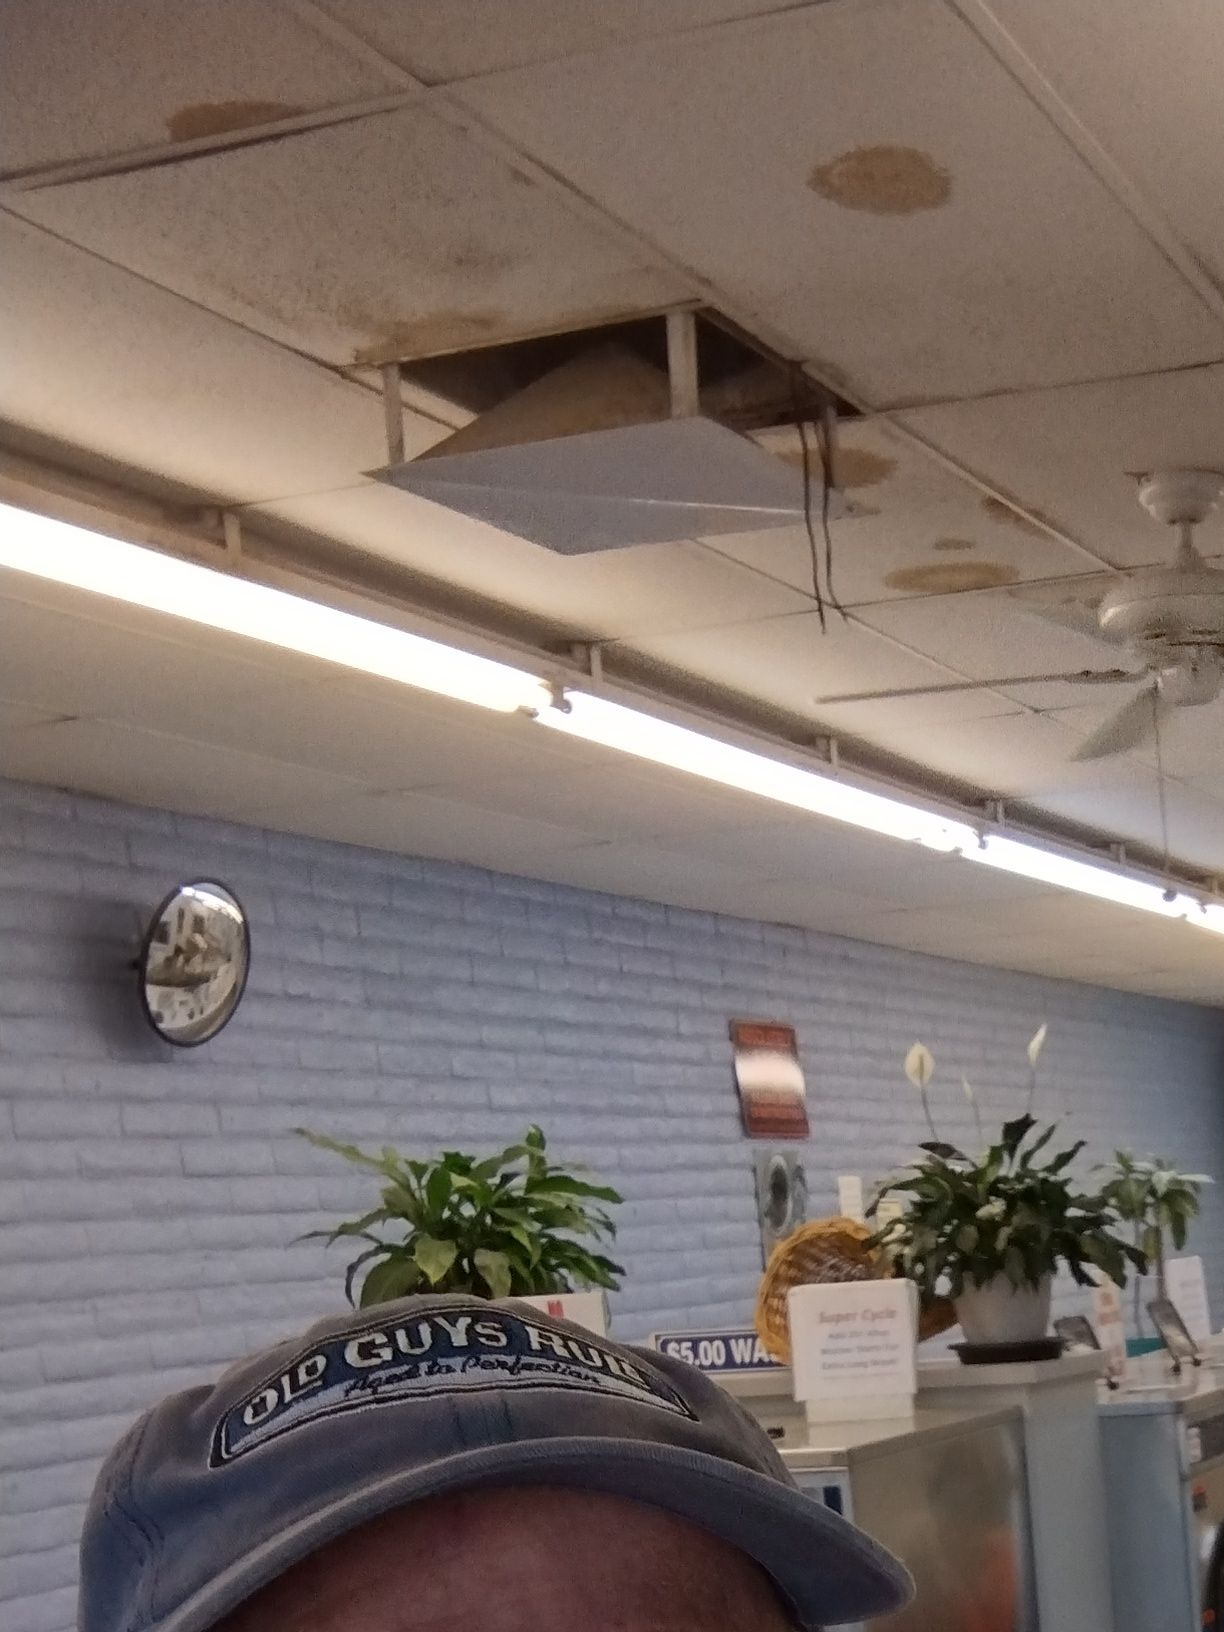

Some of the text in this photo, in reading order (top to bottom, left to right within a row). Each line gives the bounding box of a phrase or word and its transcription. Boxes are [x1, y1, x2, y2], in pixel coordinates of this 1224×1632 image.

[243, 1354, 328, 1426] OLD
[344, 1315, 508, 1369] GUYS
[729, 1337, 776, 1365] WA
